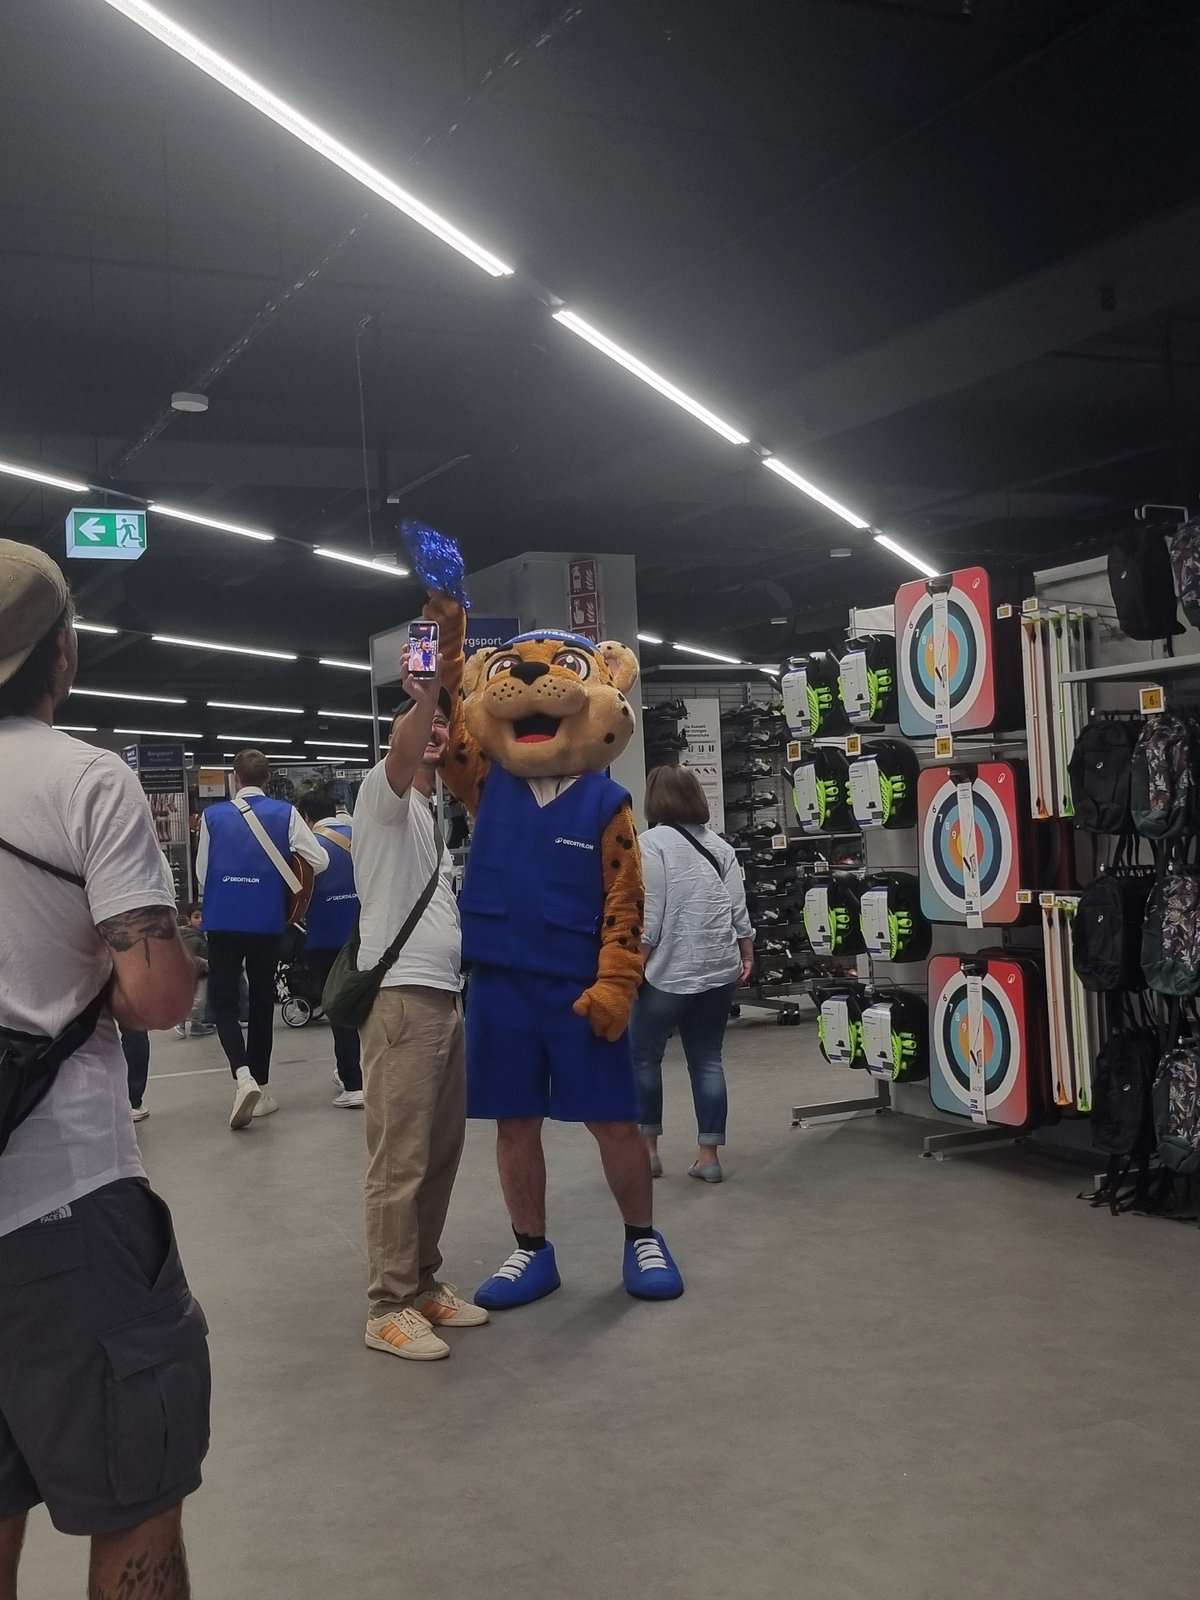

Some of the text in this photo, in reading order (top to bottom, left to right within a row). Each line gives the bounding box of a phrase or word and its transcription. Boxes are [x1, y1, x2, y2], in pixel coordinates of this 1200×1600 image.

[908, 620, 914, 629] 6
[915, 628, 920, 638] 7
[928, 643, 934, 652] 9
[464, 636, 502, 648] rgsport
[932, 805, 957, 840] 6 7 8 9
[563, 839, 594, 850] DECATHLON
[230, 876, 260, 884] DECATHLON
[332, 893, 358, 901] DECATHLO
[942, 994, 967, 1033] 6 7 8 9
[40, 1213, 60, 1224] FACE
